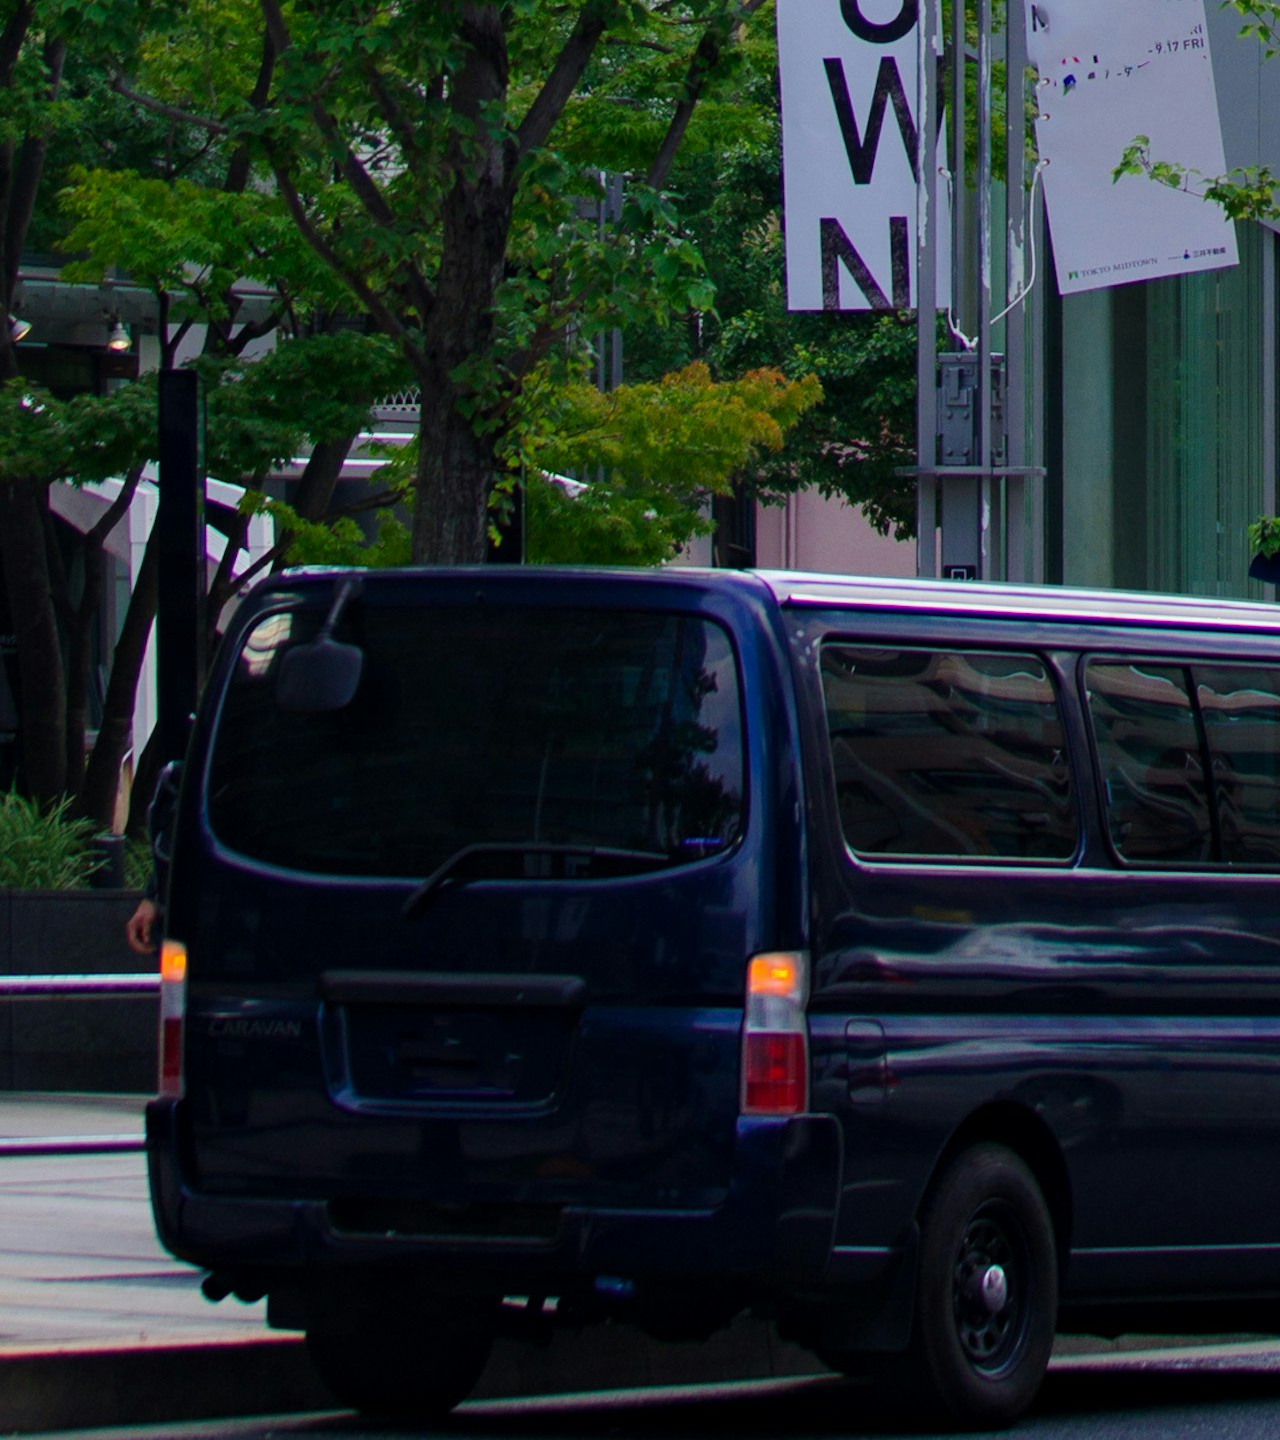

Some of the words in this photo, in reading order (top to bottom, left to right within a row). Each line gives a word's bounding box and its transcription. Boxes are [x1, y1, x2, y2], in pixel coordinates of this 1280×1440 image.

[1183, 38, 1205, 51] FRI
[1080, 265, 1112, 278] TOKYO
[1113, 257, 1159, 272] MIDTOWN
[208, 1020, 301, 1036] CARAVAN
